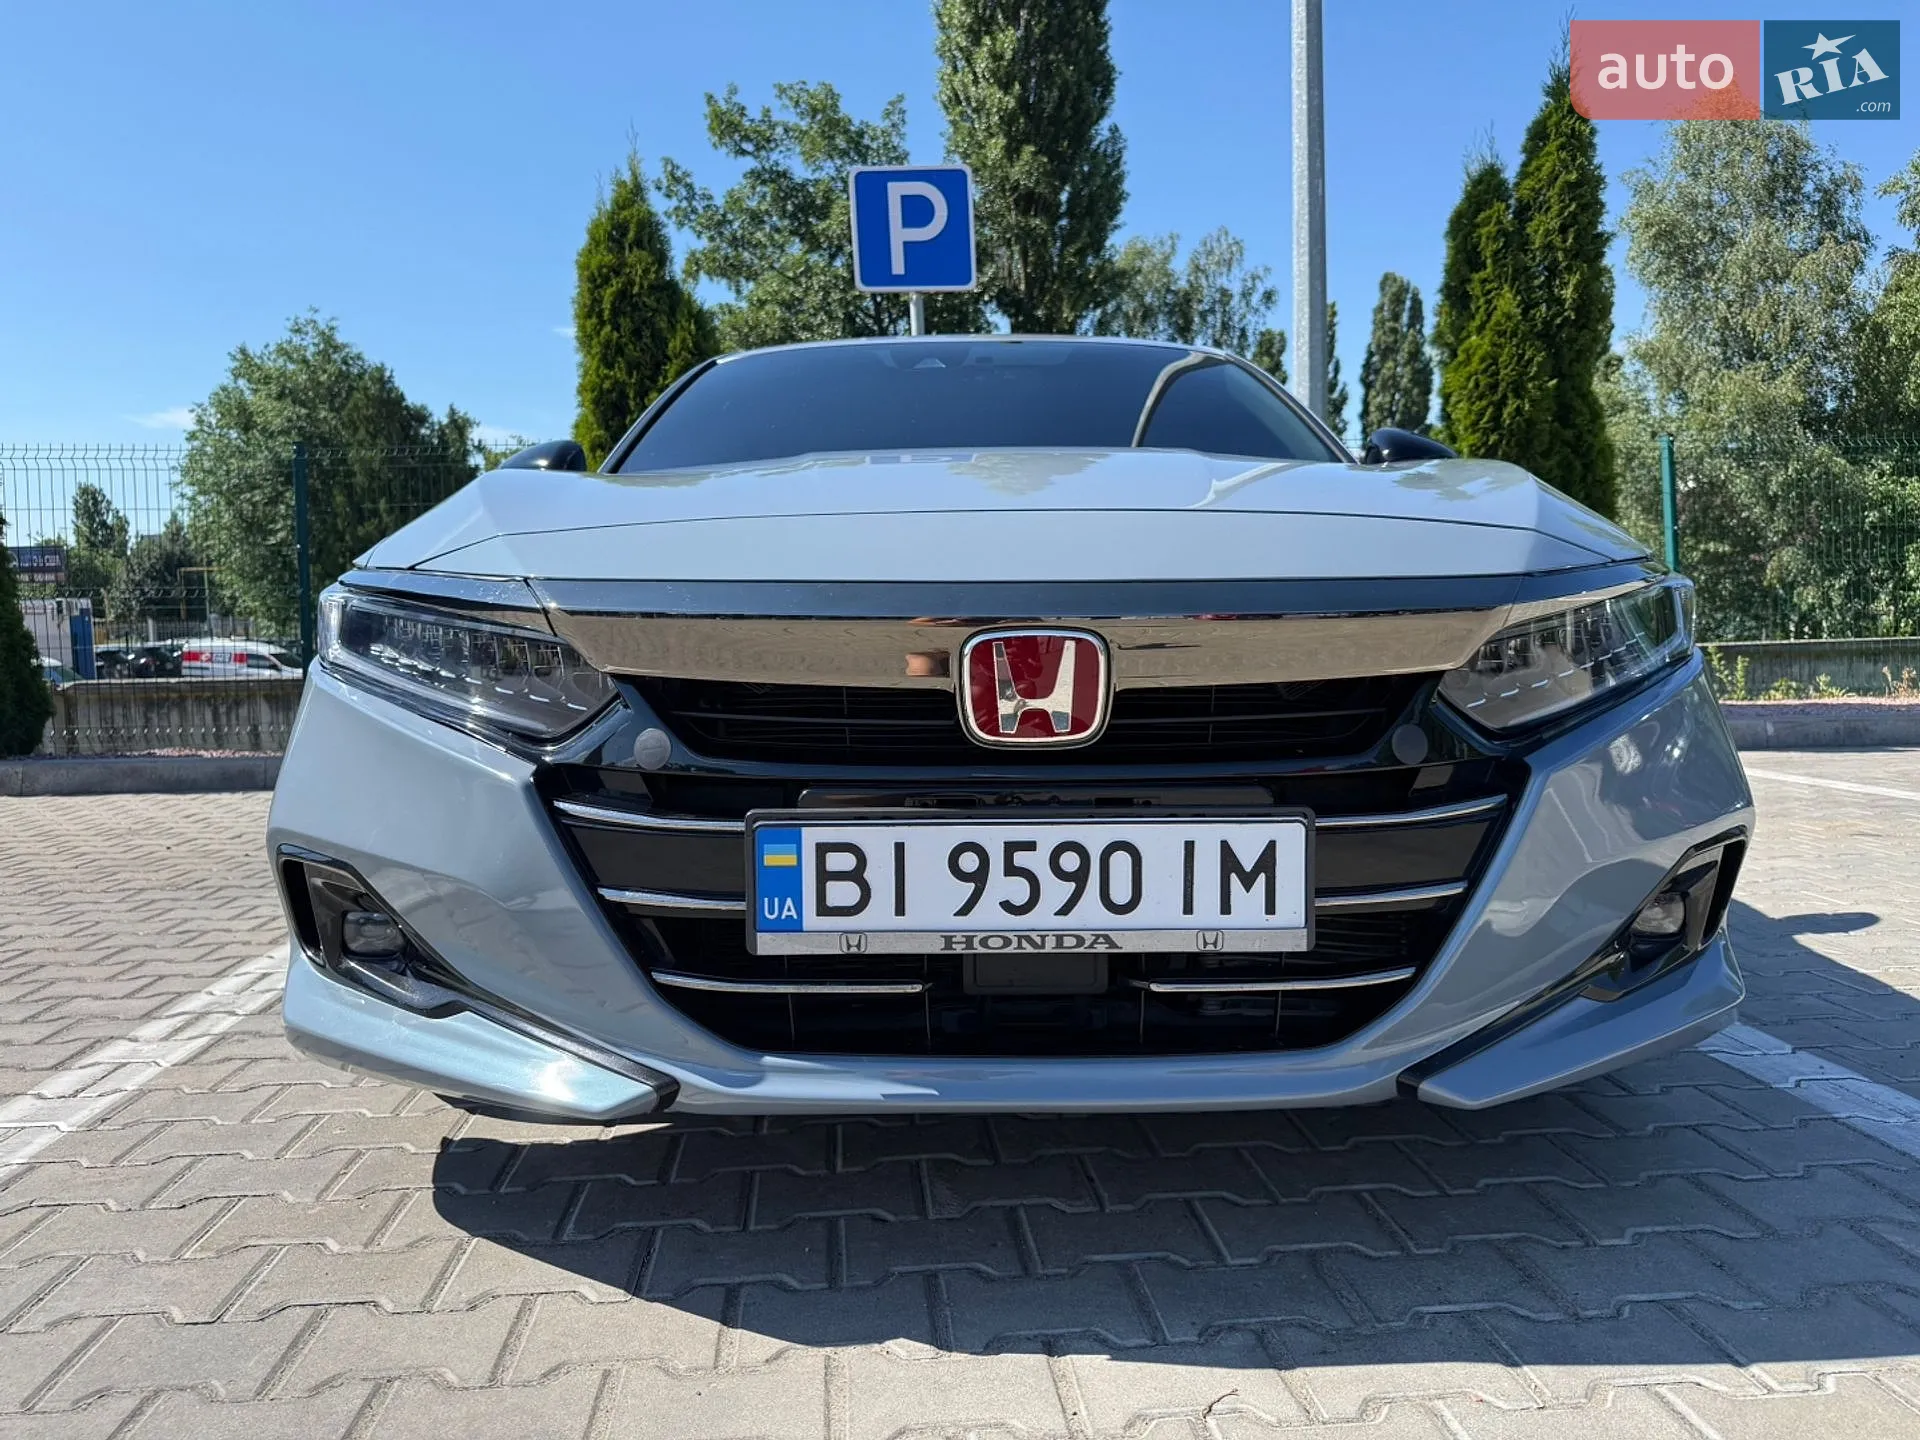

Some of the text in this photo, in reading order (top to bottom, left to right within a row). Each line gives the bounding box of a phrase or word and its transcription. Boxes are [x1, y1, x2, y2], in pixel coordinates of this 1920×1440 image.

[887, 181, 949, 275] P
[815, 838, 1279, 918] BI 9590 IM
[763, 897, 799, 920] UA
[939, 933, 1123, 952] HONDA
